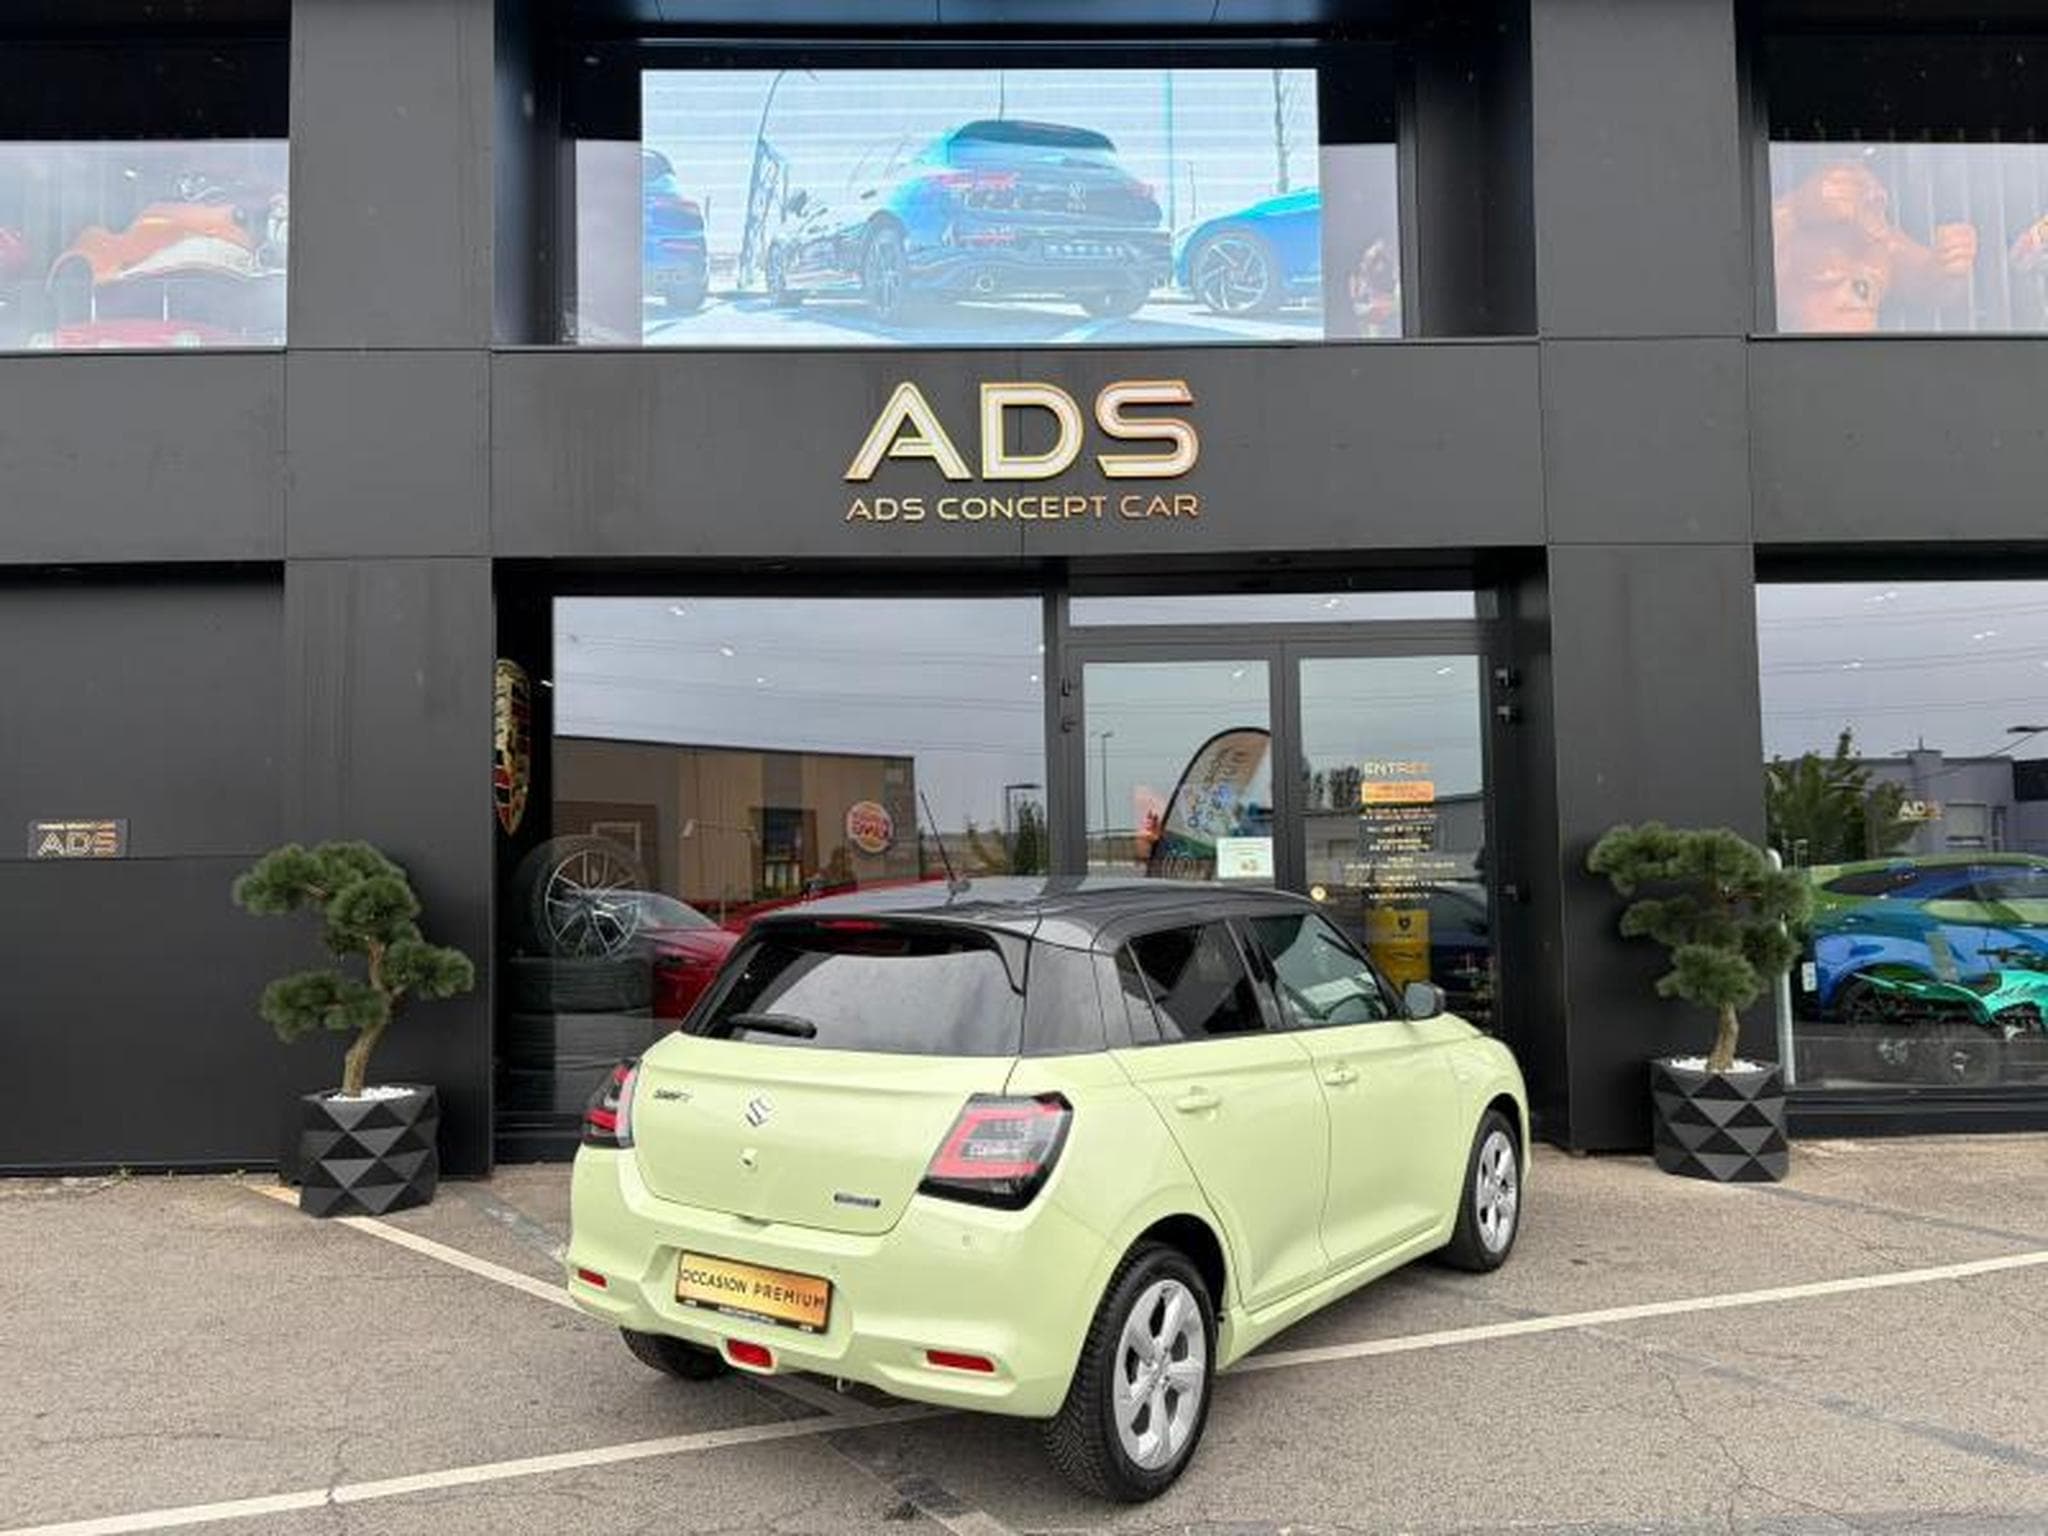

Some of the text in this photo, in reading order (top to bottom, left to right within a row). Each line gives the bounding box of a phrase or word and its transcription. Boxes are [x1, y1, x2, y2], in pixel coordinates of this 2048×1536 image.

[844, 381, 1199, 480] ADS
[846, 494, 1199, 521] ADS CONCEPT CAR
[681, 1268, 826, 1308] OCCASION PREMIUM
